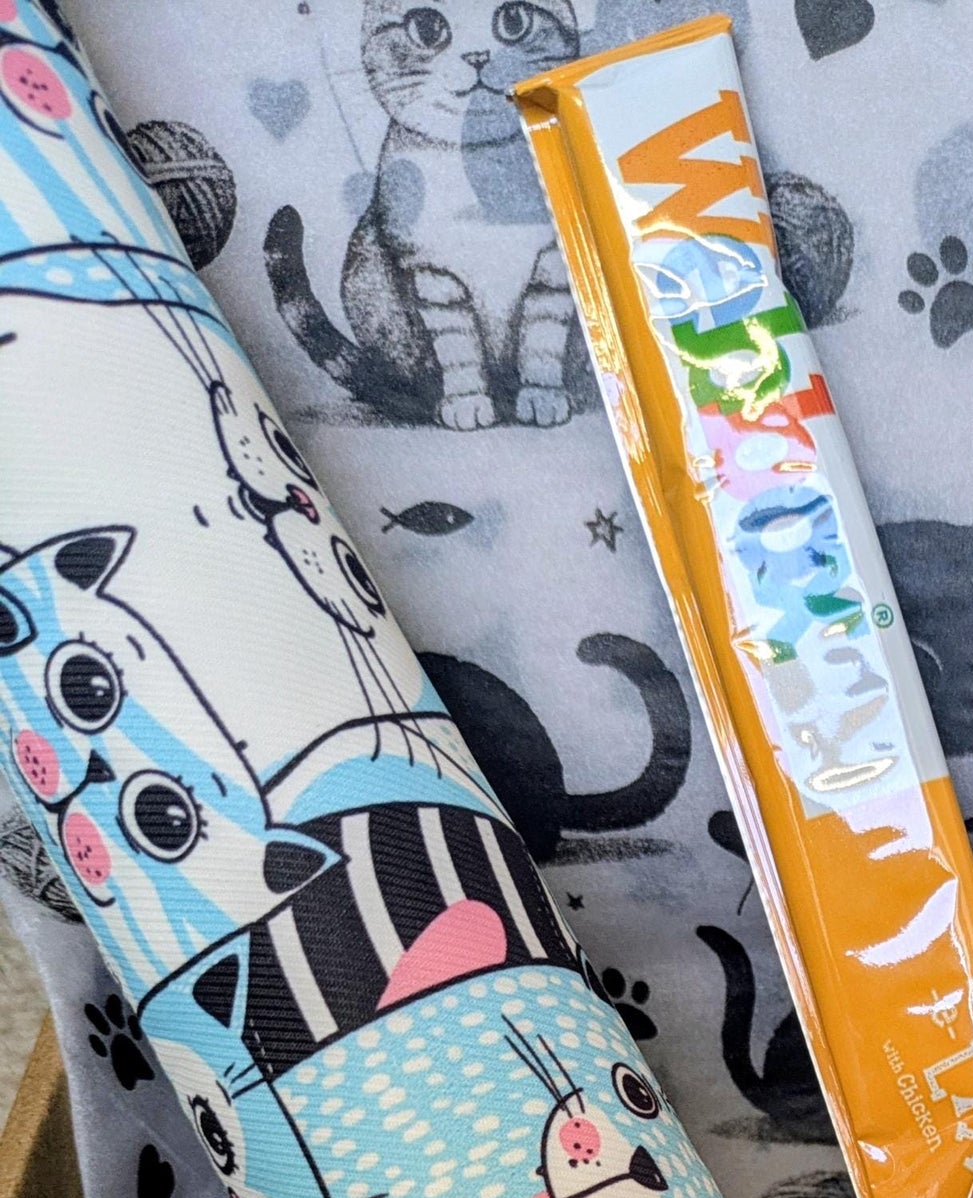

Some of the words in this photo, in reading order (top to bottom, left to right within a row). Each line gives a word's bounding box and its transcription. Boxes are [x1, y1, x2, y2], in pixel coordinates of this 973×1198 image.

[617, 90, 870, 664] Webbox
[882, 1040, 905, 1076] with
[897, 1073, 943, 1152] Chicken
